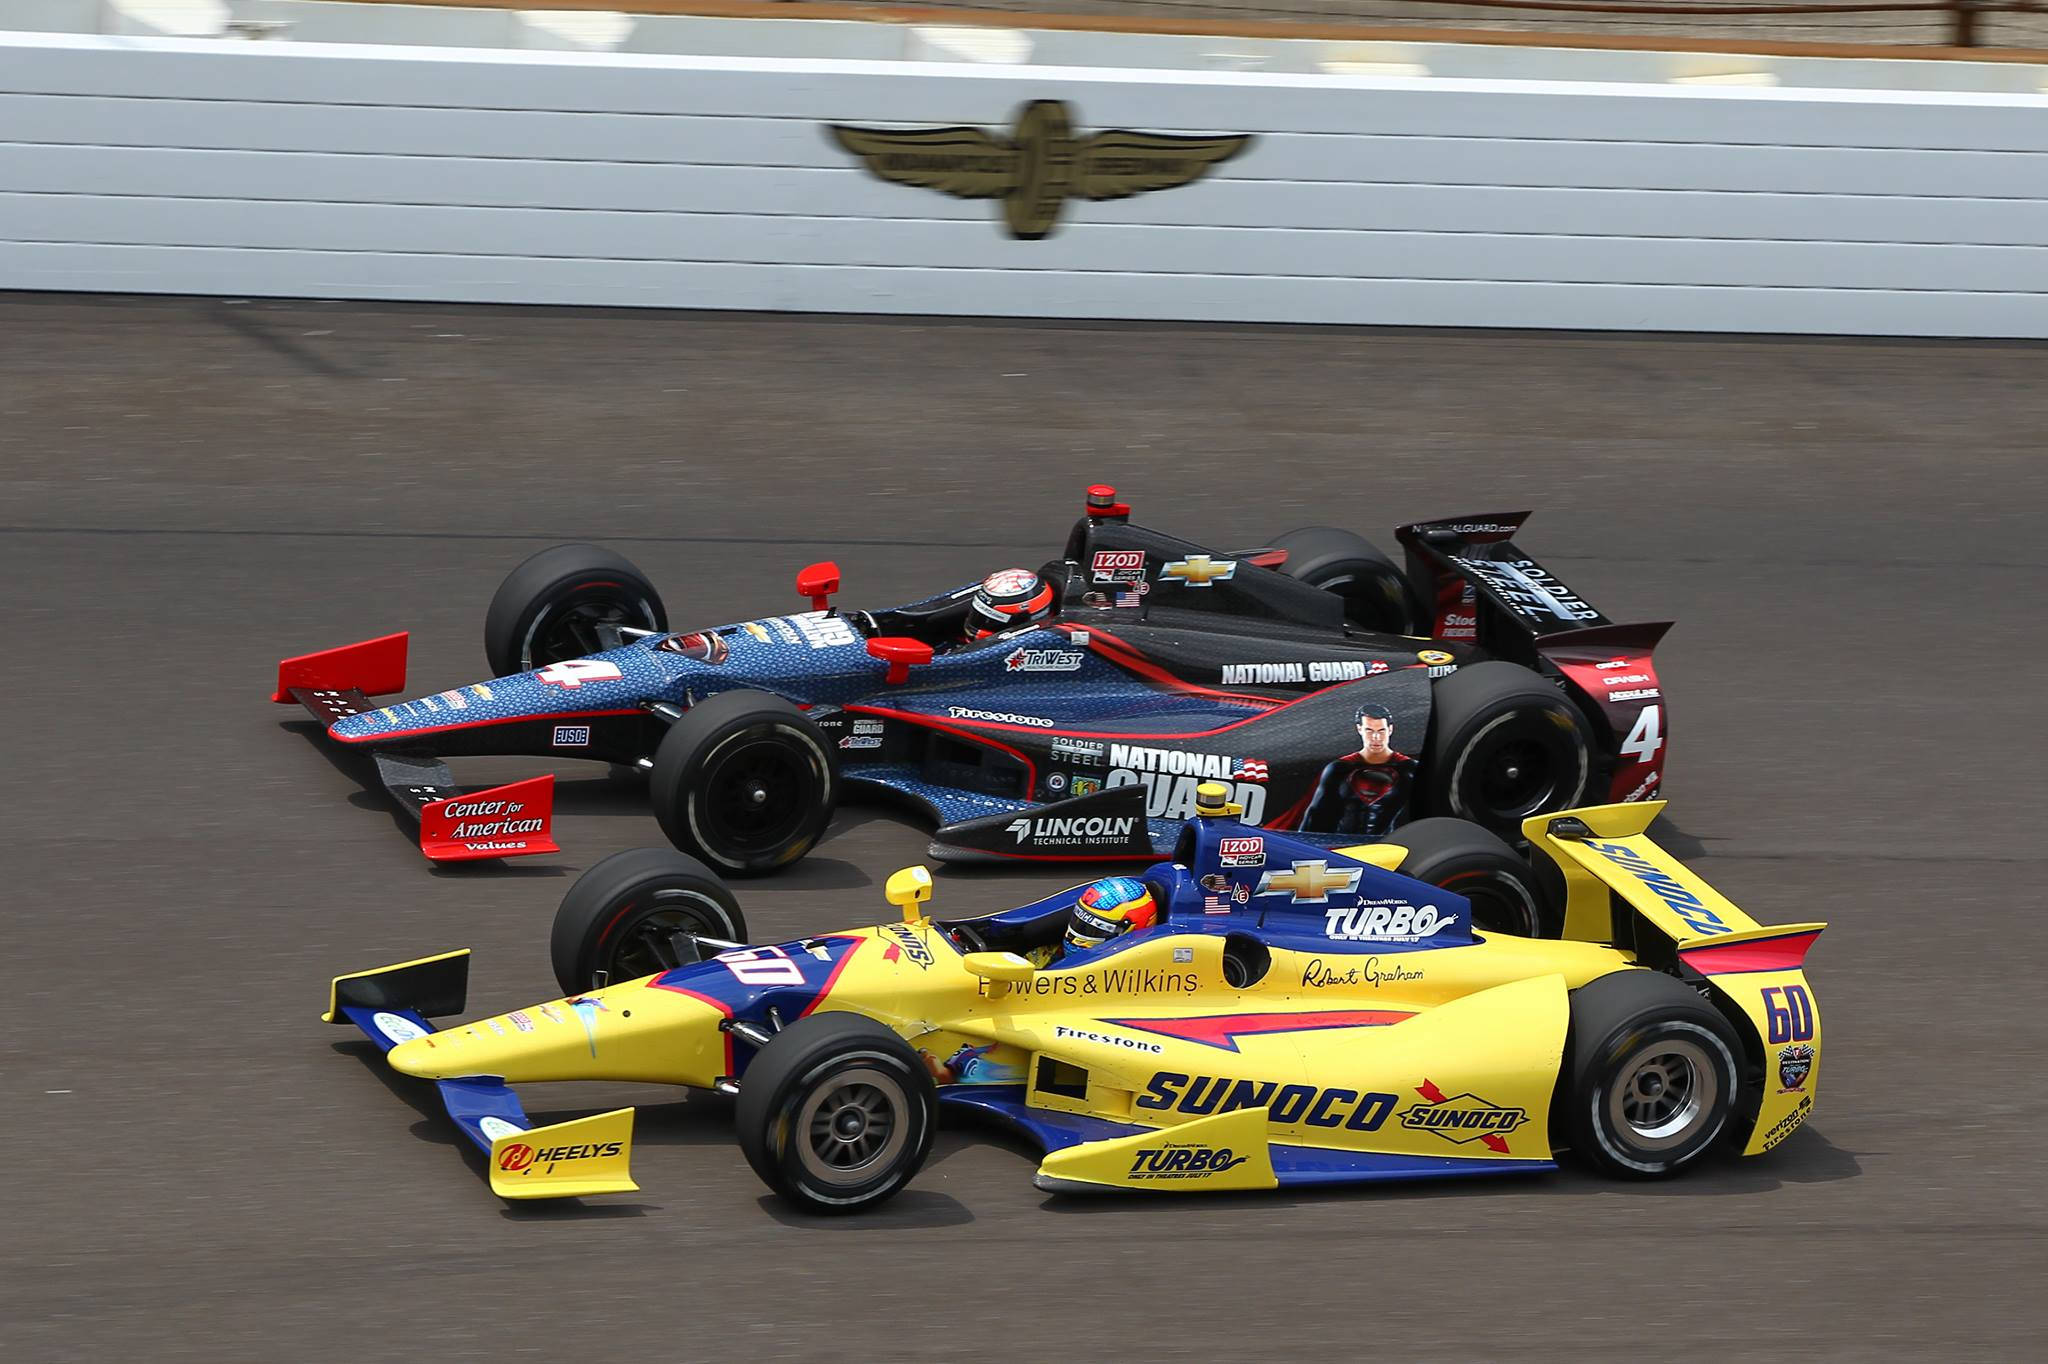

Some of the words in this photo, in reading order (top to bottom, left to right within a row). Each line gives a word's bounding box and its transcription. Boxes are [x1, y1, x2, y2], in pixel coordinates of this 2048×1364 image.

[1095, 553, 1140, 567] IZOD
[1461, 557, 1552, 617] STEEL
[1509, 559, 1599, 621] SOLDIER
[535, 659, 624, 690] 4
[1221, 662, 1306, 685] NATIONAL
[1308, 661, 1366, 683] GUARD
[852, 724, 884, 735] GUARD
[948, 706, 1055, 728] Firestone
[560, 729, 583, 742] USO
[1051, 736, 1105, 750] SOLDIER
[1620, 704, 1664, 764] 4
[1050, 750, 1106, 767] STEEL
[1109, 743, 1234, 780] NATIONAL
[444, 799, 507, 818] Center
[502, 802, 524, 816] for
[451, 817, 544, 838] American
[1034, 817, 1134, 837] LINCOLN
[1033, 837, 1082, 846] TECHNICAL
[1084, 836, 1130, 845] INSTITUTE
[1222, 840, 1260, 853] IZOD
[1579, 838, 1734, 935] SUNOCO
[1324, 904, 1457, 937] TURBO
[712, 945, 807, 986] 60
[1301, 958, 1360, 988] Robert
[1363, 956, 1424, 988] Graham
[1082, 973, 1099, 995] &
[1102, 968, 1199, 995] Wilkins
[1760, 984, 1814, 1045] 60
[1055, 1025, 1163, 1054] Firestone
[1135, 1071, 1400, 1132] SUNOCO
[1406, 1107, 1520, 1129] SUNOCO
[1763, 1106, 1812, 1151] Firestone
[1764, 1106, 1799, 1140] verizon
[533, 1141, 624, 1163] HEELYS
[1130, 1148, 1248, 1172] TURBO
